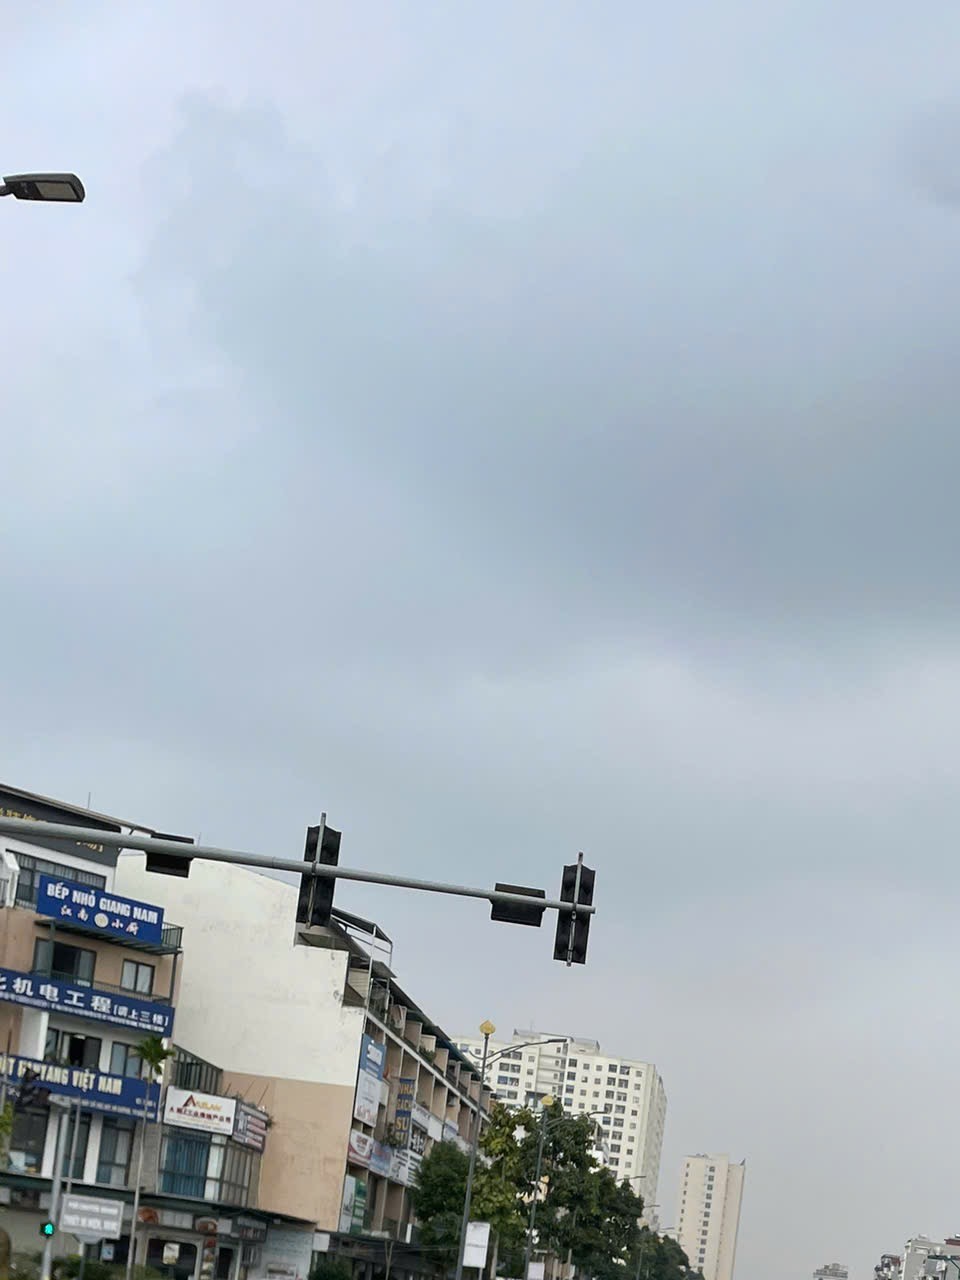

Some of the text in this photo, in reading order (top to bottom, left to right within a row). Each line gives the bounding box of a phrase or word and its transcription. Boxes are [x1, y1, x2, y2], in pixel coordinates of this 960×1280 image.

[47, 882, 158, 924] BẾP NHỎ GIANG NAM
[72, 1068, 96, 1092] VIỆT
[98, 1076, 122, 1096] NAM
